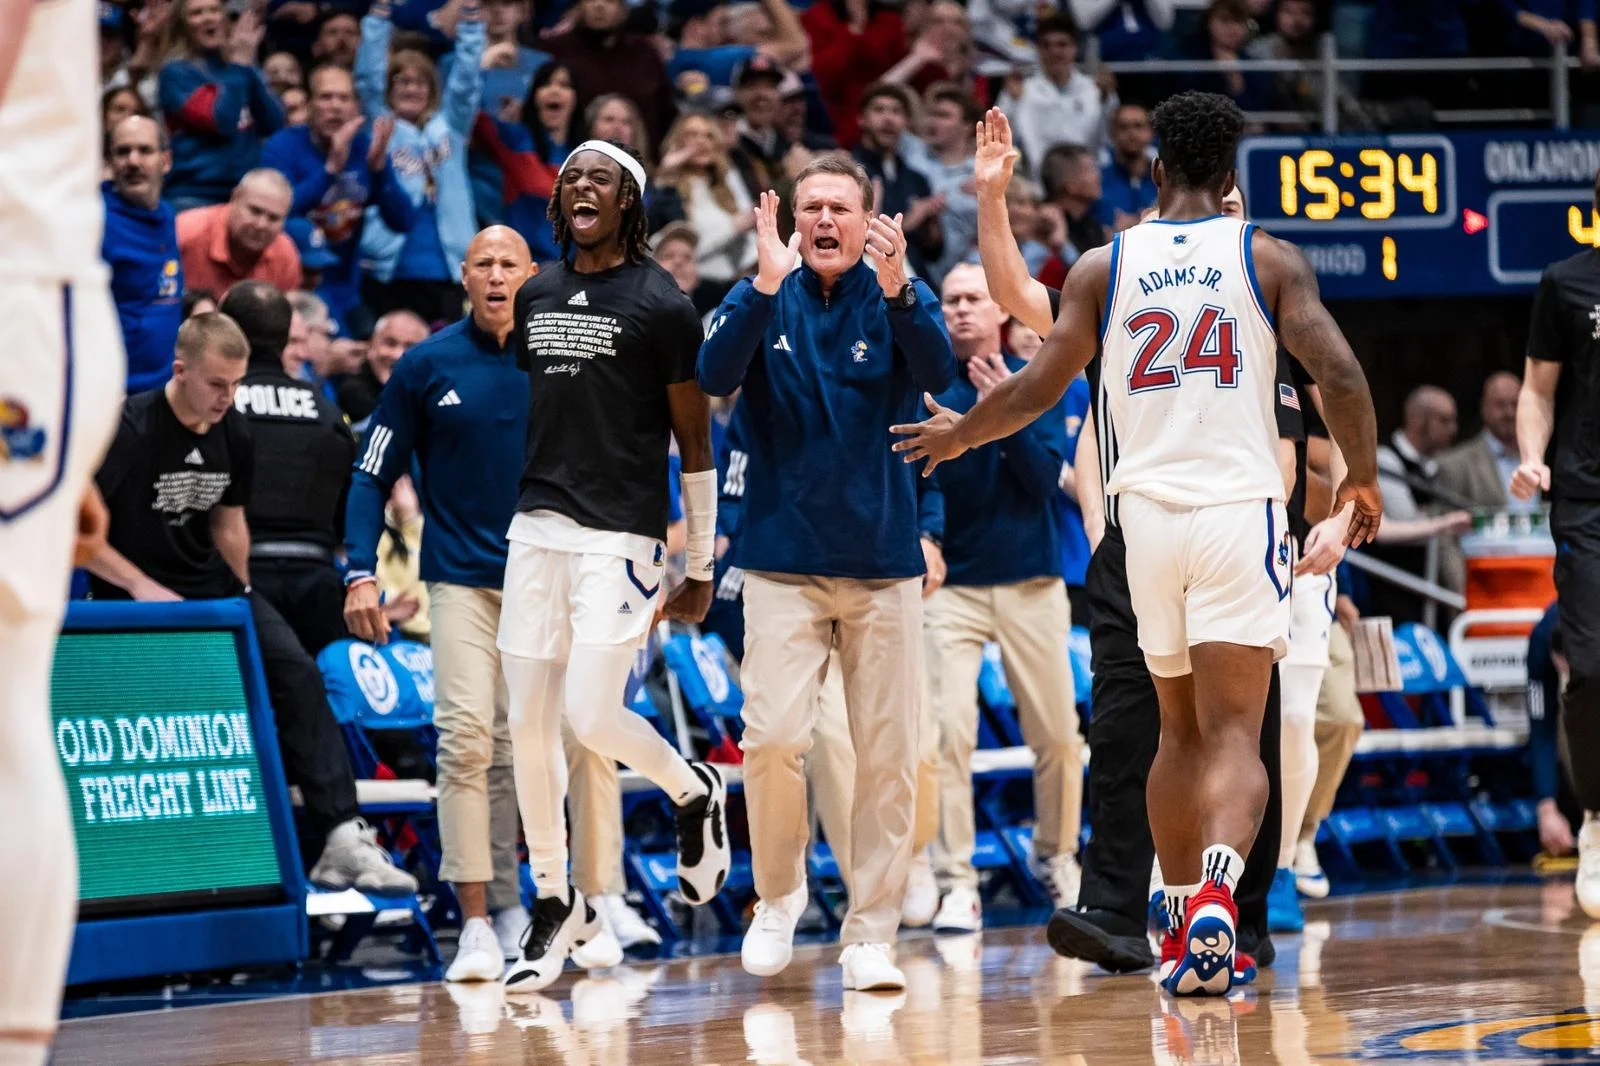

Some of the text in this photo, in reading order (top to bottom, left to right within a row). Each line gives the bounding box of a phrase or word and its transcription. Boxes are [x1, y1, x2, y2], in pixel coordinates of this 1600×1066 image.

[1280, 149, 1438, 220] 15:34
[1303, 243, 1367, 276] RIOD
[1382, 236, 1398, 281] 1
[1138, 265, 1223, 296] ADAMS JR.
[530, 326, 558, 334] MOMENTS
[567, 327, 598, 336] COMFORT
[597, 330, 613, 339] AND
[543, 312, 573, 320] ULTIMATE
[572, 314, 602, 323] MEASURE
[601, 316, 612, 324] OF
[557, 320, 579, 328] WHERE
[579, 321, 589, 329] HE
[588, 322, 614, 332] STANDS
[613, 326, 622, 334] IN
[537, 348, 548, 356] AND
[542, 340, 551, 348] AT
[550, 340, 568, 349] TIMES
[568, 341, 578, 349] OF
[577, 342, 617, 357] CHALLENGE
[566, 334, 580, 342] BUT
[579, 335, 603, 346] WHERE
[602, 340, 613, 348] HE
[1122, 303, 1243, 395] 24
[234, 384, 319, 419] POLICE
[57, 712, 252, 766] OLD DOMINION
[79, 767, 257, 823] FREIGHT LINE
